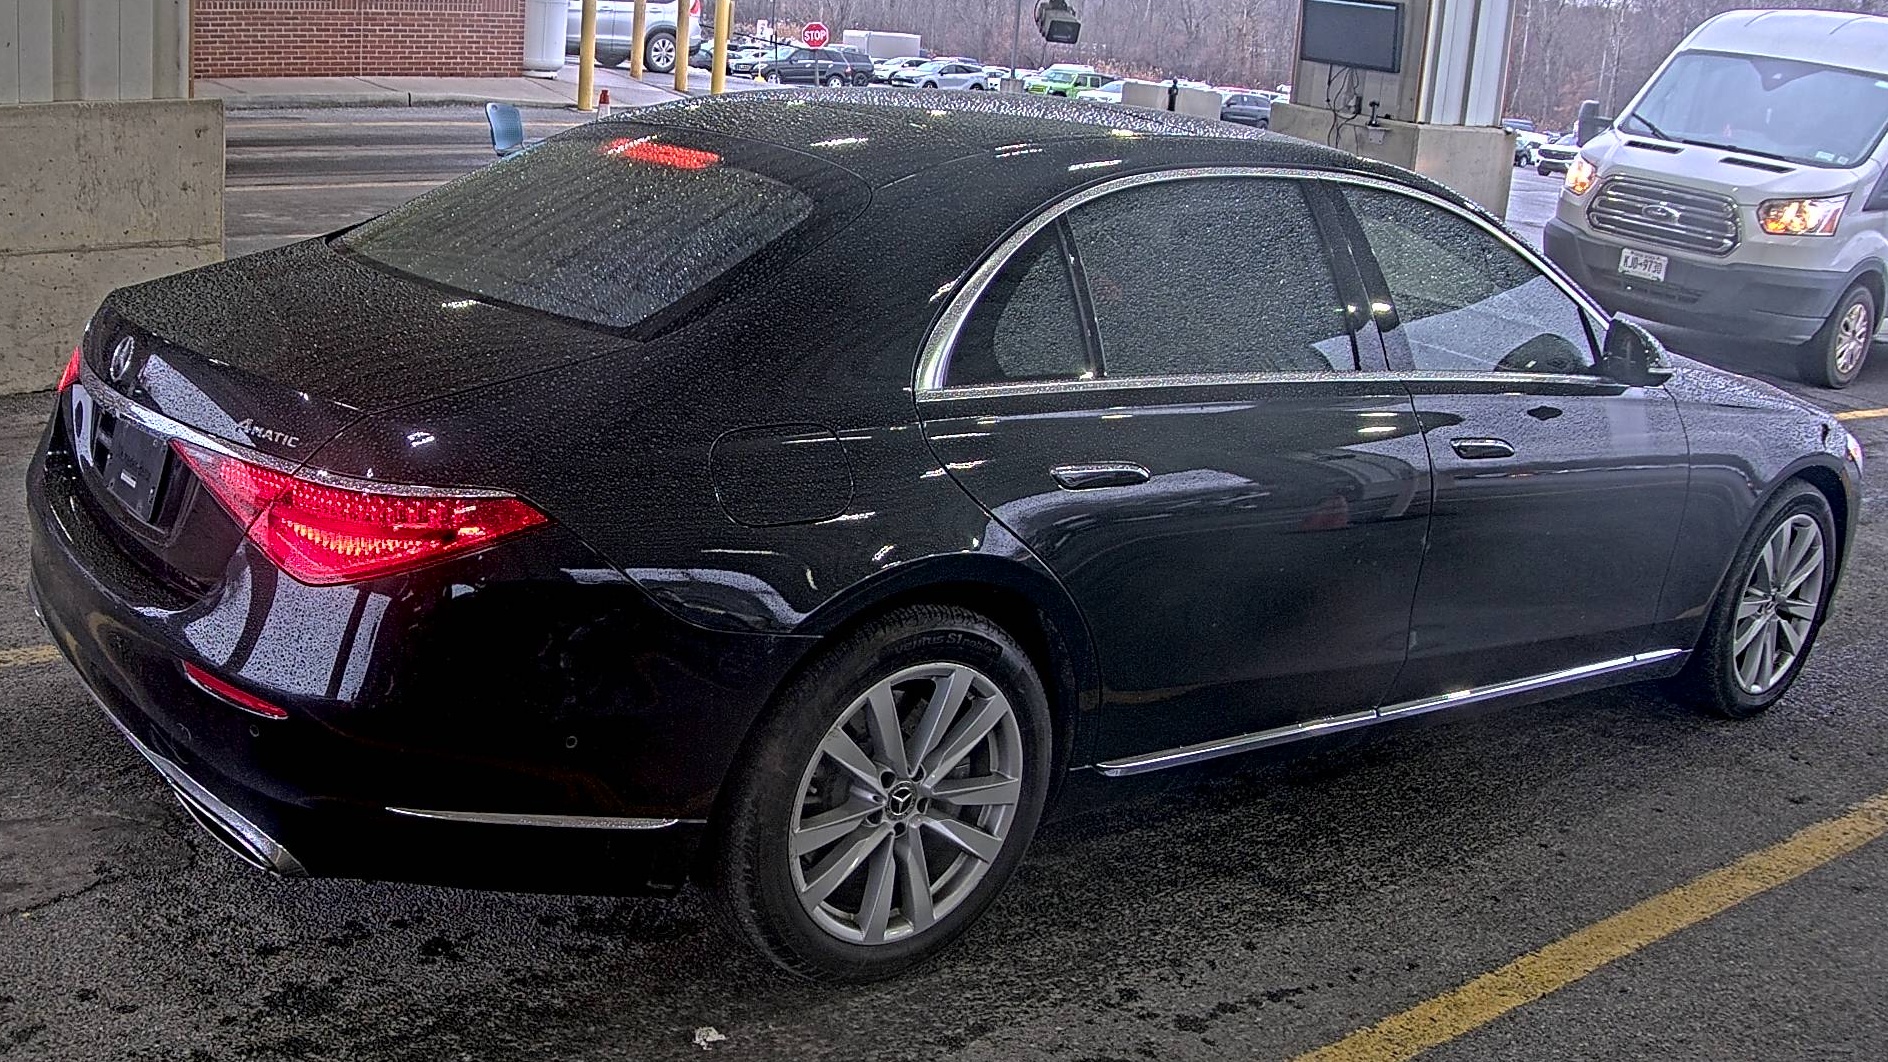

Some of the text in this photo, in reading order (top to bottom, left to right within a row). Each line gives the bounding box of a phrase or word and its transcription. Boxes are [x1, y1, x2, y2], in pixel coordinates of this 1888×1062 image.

[804, 30, 827, 41] STOP
[238, 417, 300, 448] 4MATIC
[946, 632, 963, 645] S1
